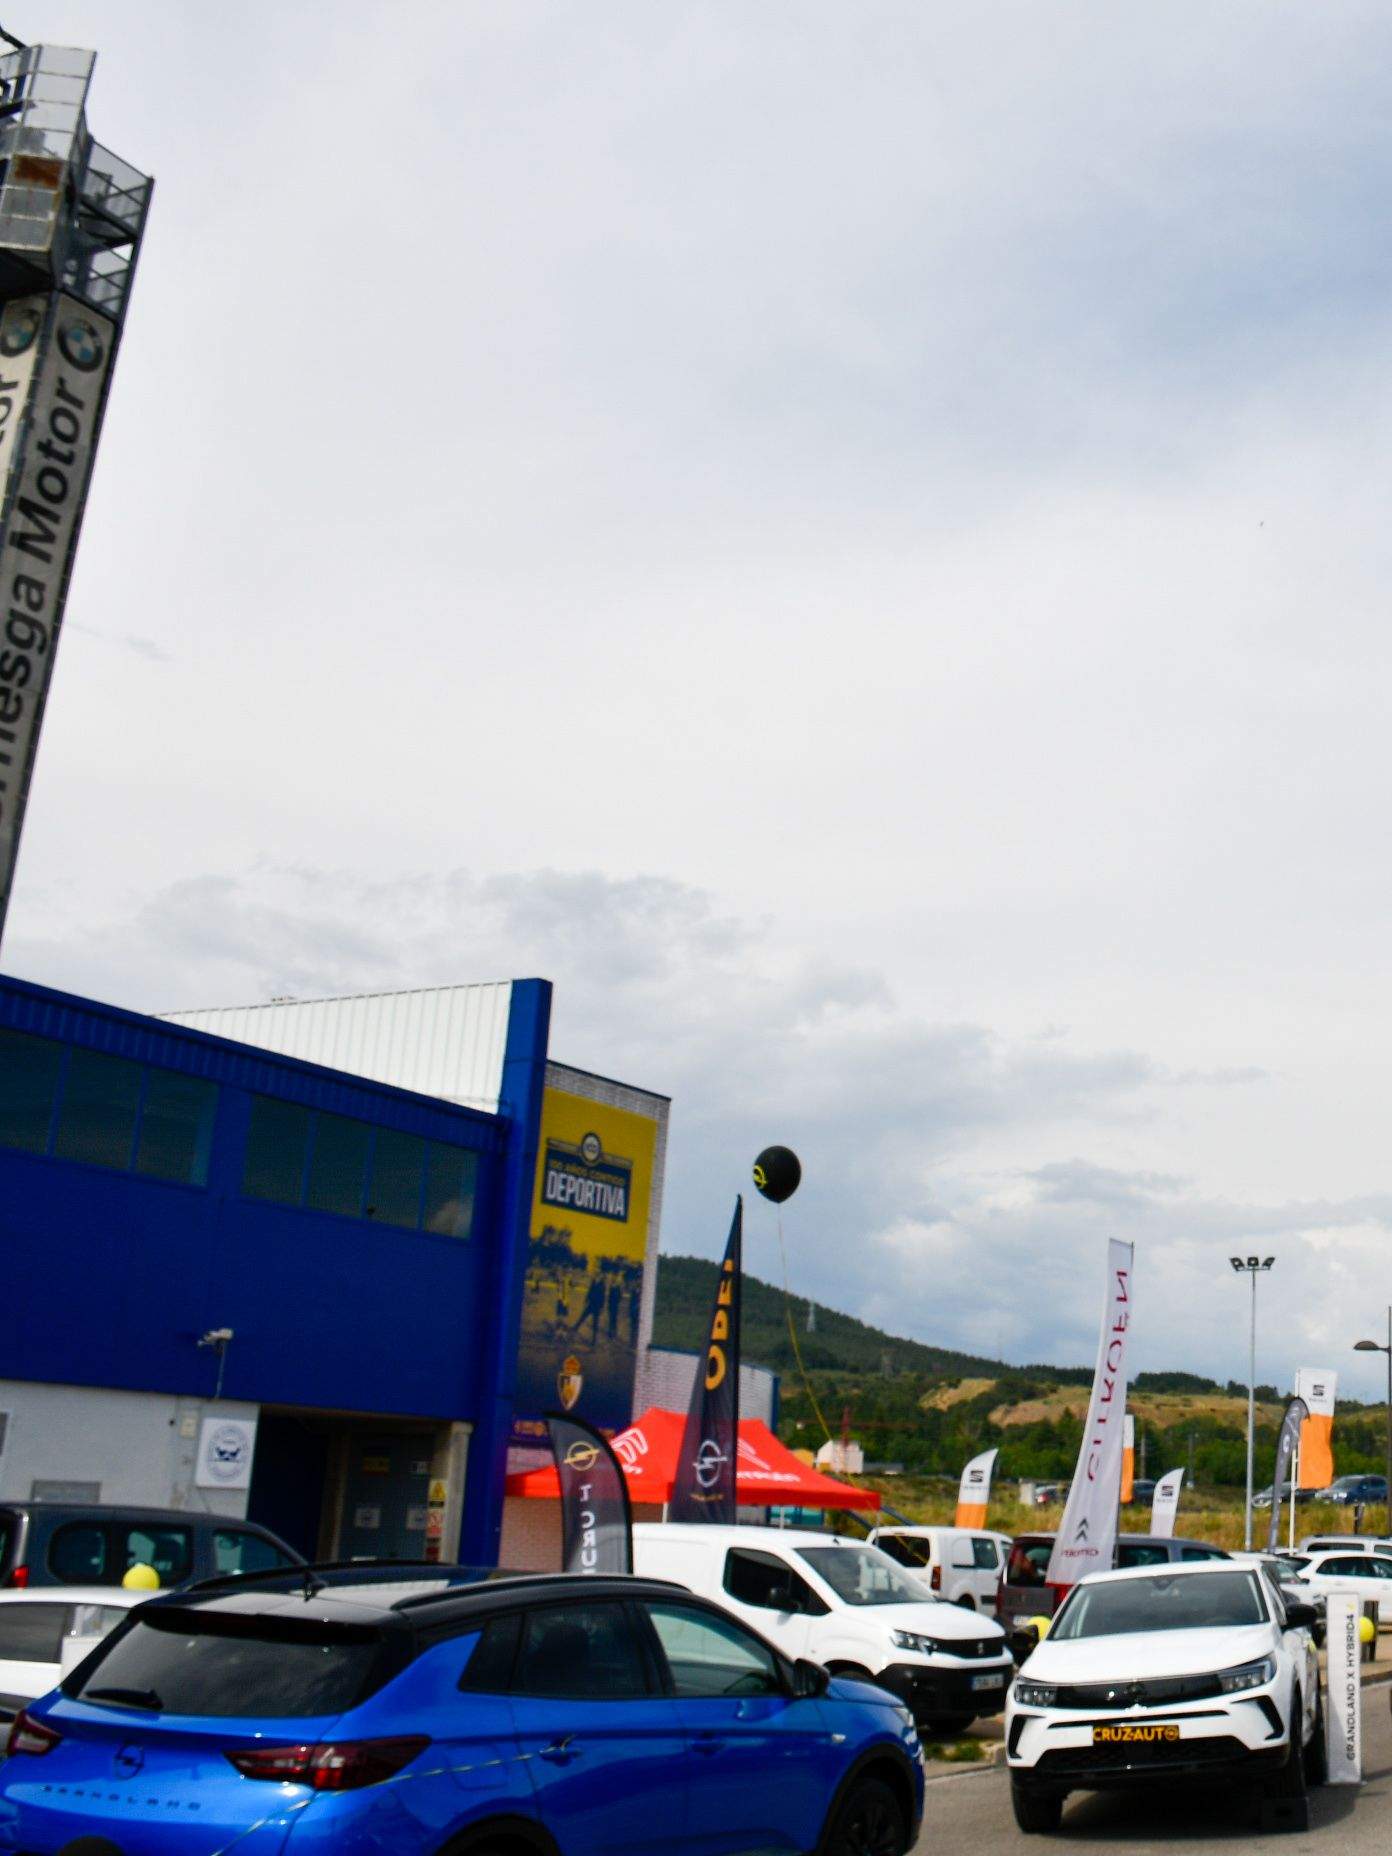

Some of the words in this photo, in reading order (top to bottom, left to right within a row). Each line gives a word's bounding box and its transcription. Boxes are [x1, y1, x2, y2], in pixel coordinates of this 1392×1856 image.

[8, 376, 86, 564] Motor
[545, 1170, 625, 1217] DEPORTIVA
[1346, 1670, 1355, 1680] X
[1345, 1684, 1356, 1761] GRANDLAND
